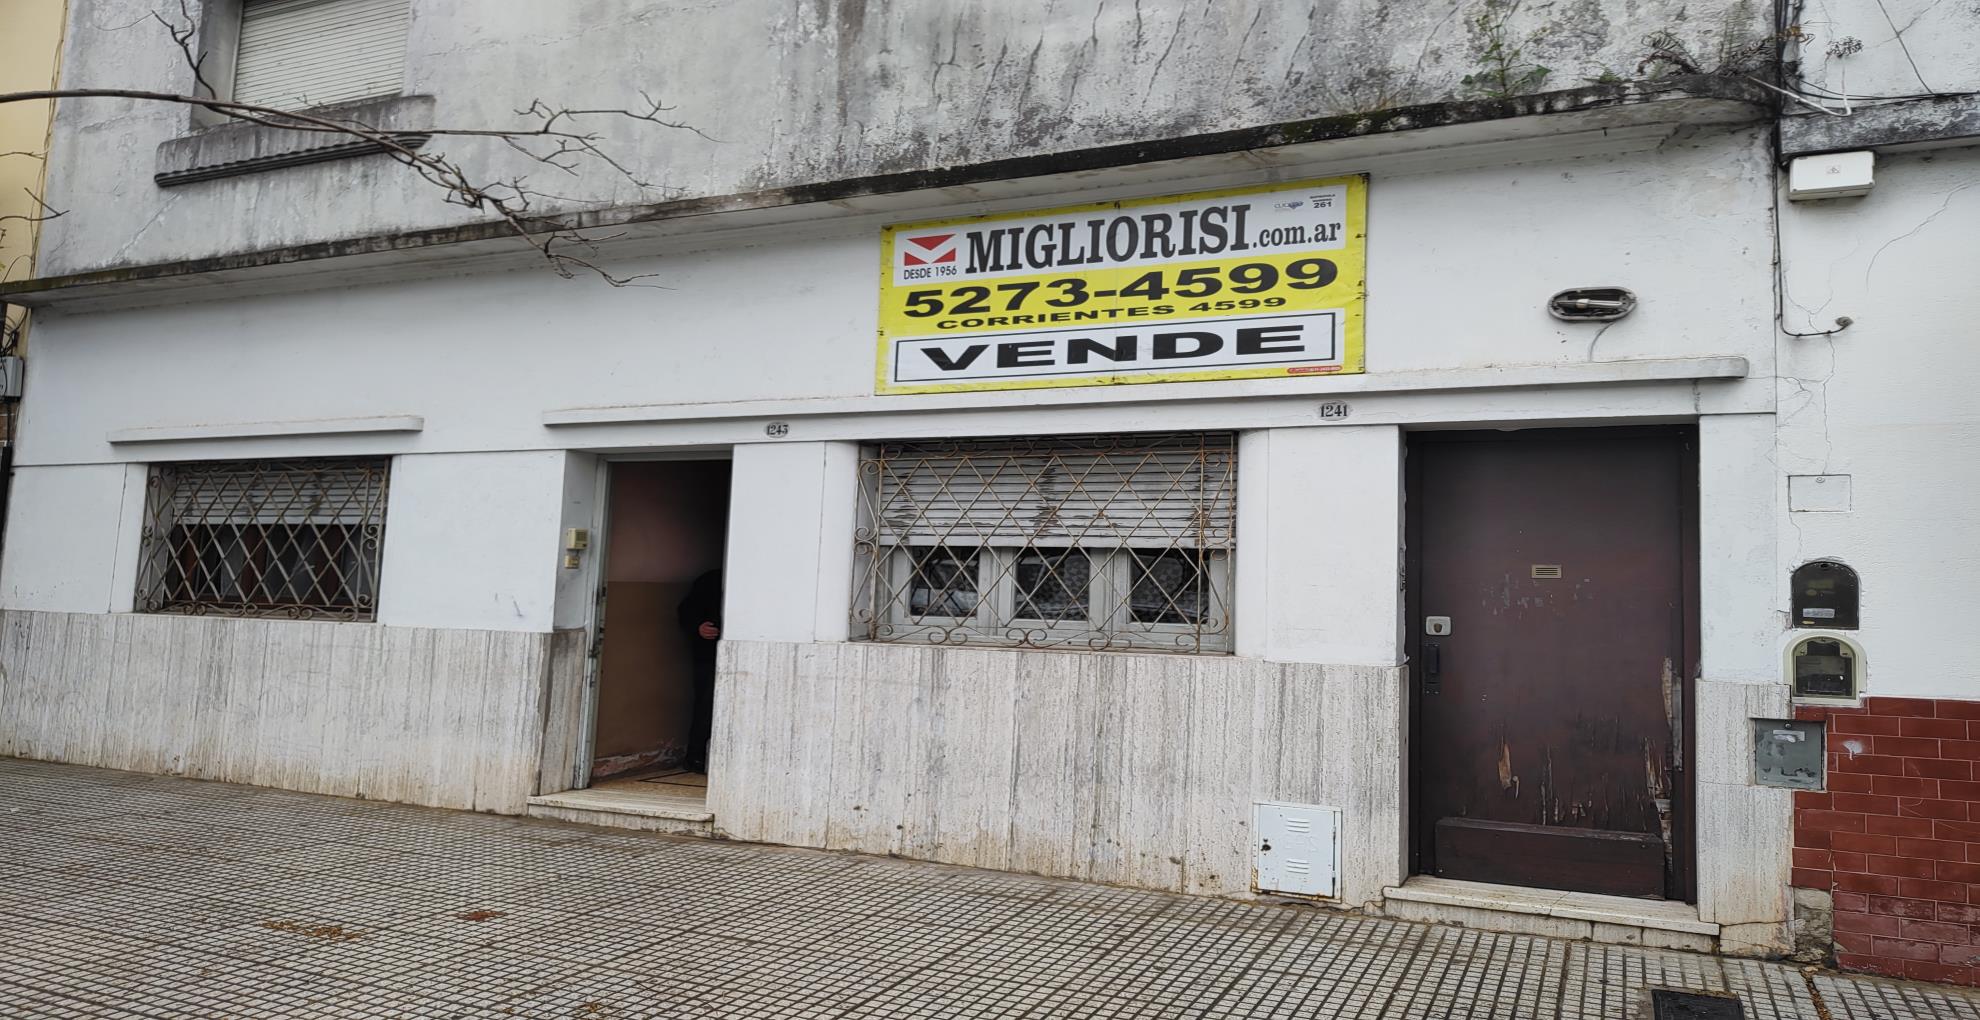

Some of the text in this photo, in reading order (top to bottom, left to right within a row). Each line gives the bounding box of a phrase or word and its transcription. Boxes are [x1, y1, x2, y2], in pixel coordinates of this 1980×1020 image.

[1313, 201, 1332, 209] 261
[904, 265, 958, 280] DESDE 1956
[903, 257, 1338, 318] 5273-4599
[936, 297, 1287, 330] CORRIENTES 4599
[920, 325, 1305, 371] VENDE
[1320, 404, 1348, 417] 1241
